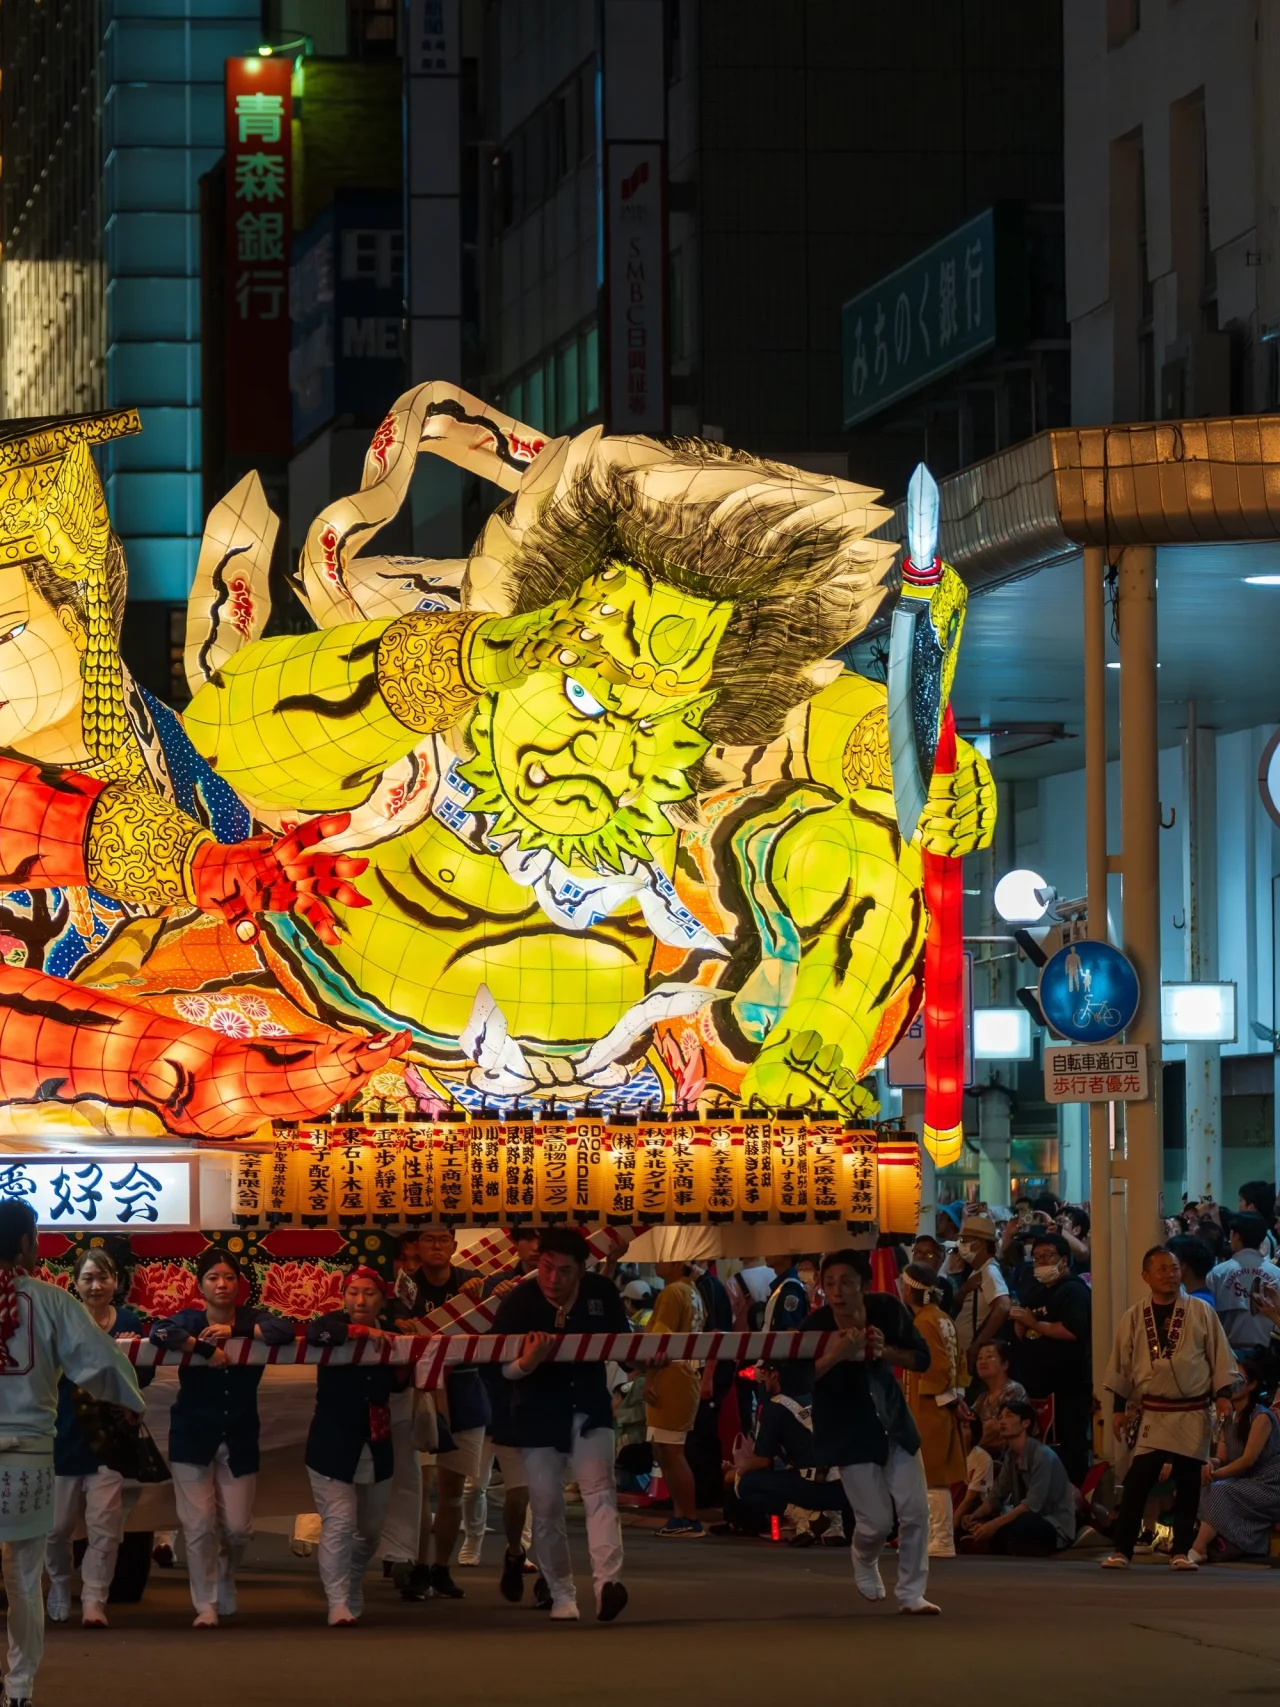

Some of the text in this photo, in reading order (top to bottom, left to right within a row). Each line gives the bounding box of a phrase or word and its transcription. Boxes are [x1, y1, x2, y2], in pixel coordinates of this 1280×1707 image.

[234, 91, 286, 321] 青森銀行
[852, 237, 983, 396] みちのく銀行
[1053, 1051, 1138, 1072] 自転車通行可
[1053, 1075, 1140, 1095] 歩行者優先
[308, 1129, 331, 1210] 朴子配天宮
[340, 1128, 364, 1208] 東石小木屋
[402, 1127, 424, 1208] 定性壇
[576, 1125, 589, 1205] GARDEN
[590, 1125, 601, 1164] DOG
[612, 1132, 637, 1212] (株)福萬組
[642, 1127, 667, 1208] 秋田東北ダイケン
[672, 1126, 695, 1206] (株)東京商事
[780, 1126, 796, 1206] ヒリヒリする夏
[851, 1134, 874, 1214] 八甲法律事務所
[1225, 1268, 1250, 1290] AOMORI
